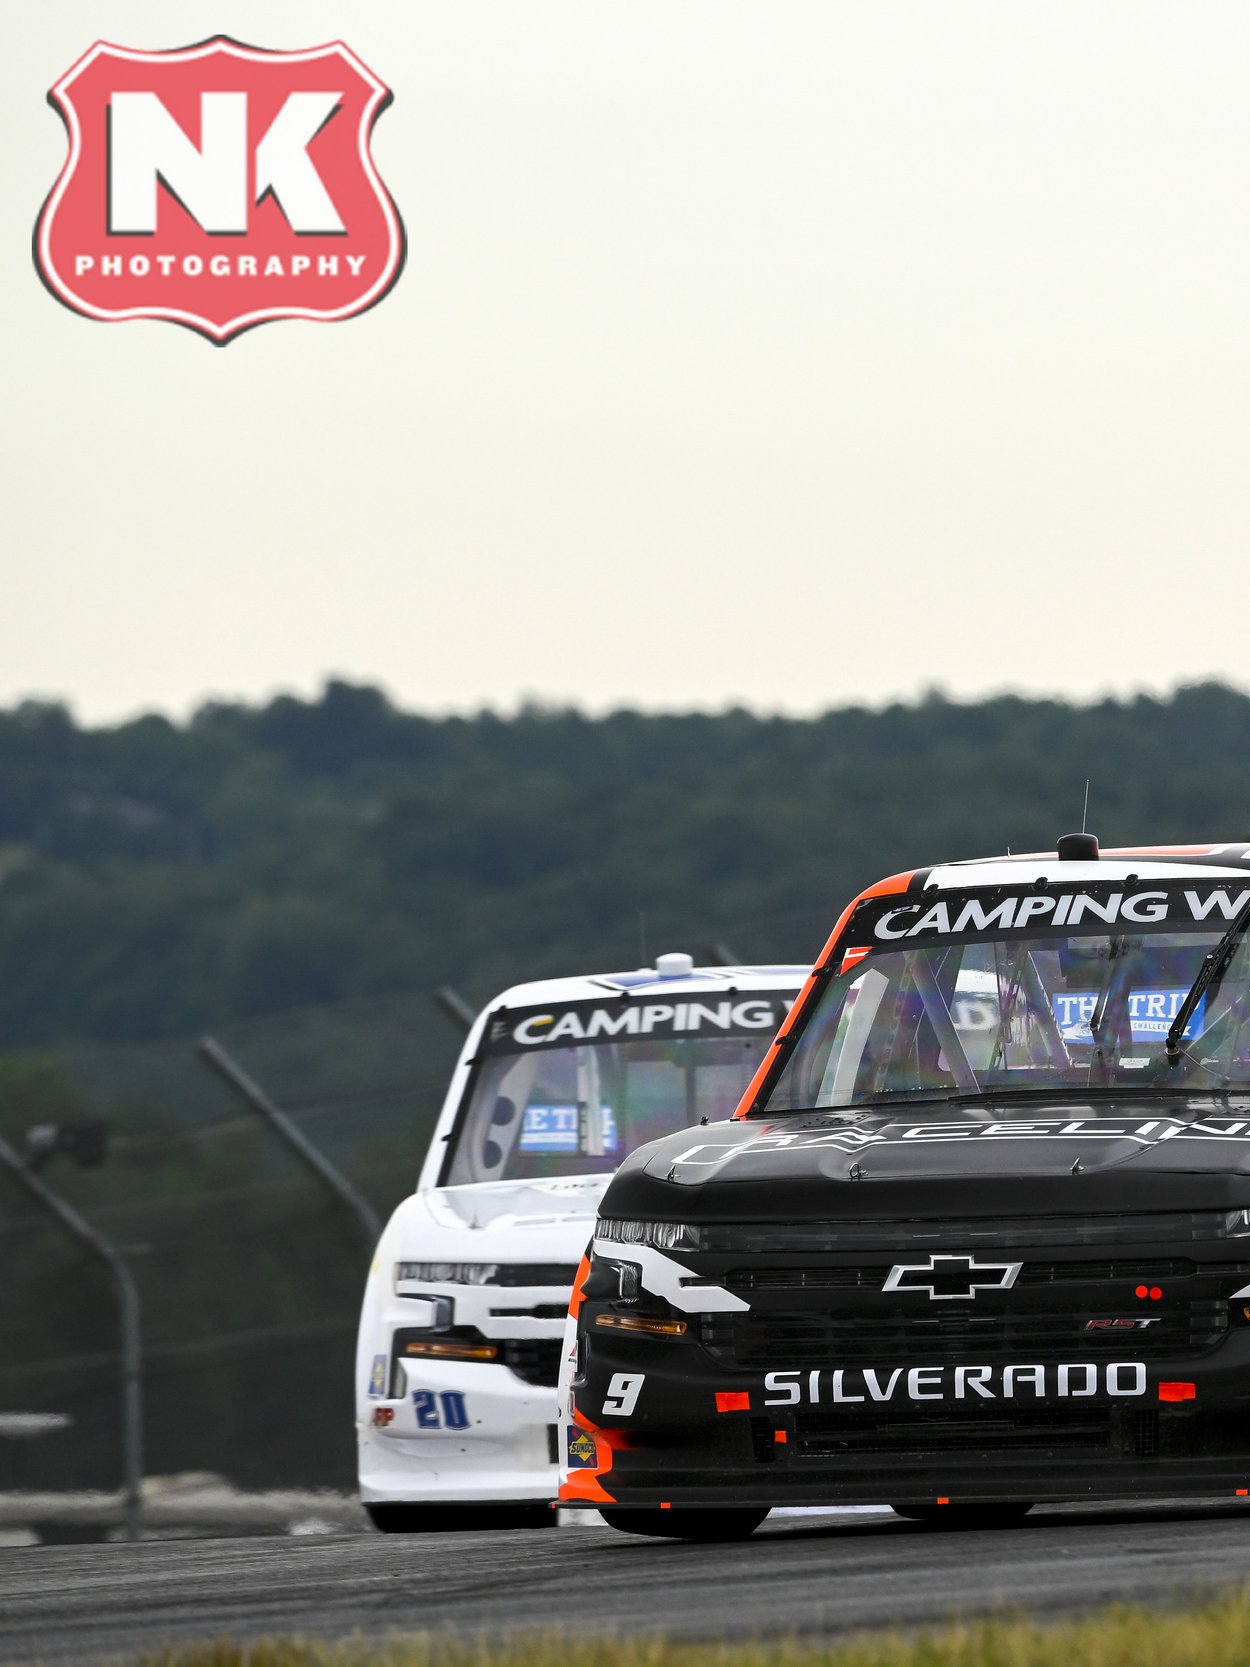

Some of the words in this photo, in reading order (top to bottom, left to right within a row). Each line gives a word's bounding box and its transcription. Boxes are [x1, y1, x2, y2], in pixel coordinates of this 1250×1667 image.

[873, 891, 1169, 940] CAMPING
[513, 1000, 775, 1045] CAMPING
[602, 1373, 646, 1417] 9
[764, 1362, 1147, 1406] SILVERADO
[411, 1388, 473, 1431] 20
